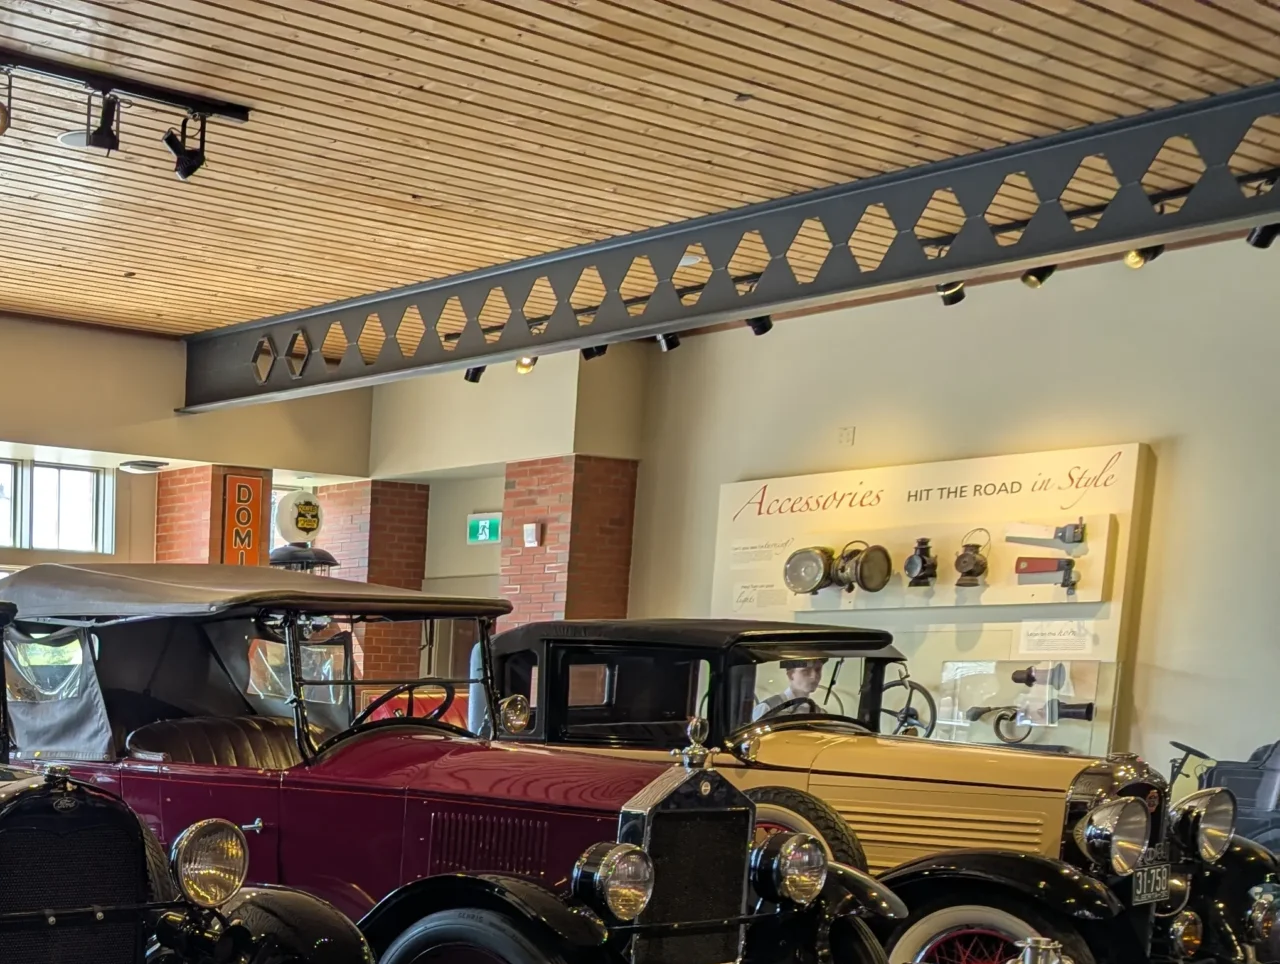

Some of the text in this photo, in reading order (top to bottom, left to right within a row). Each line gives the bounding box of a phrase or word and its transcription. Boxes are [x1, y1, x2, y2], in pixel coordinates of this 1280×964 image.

[732, 451, 1122, 522] Accessories HIT THE ROAD in Style
[232, 483, 252, 565] DOMI
[1136, 868, 1167, 894] 31-758
